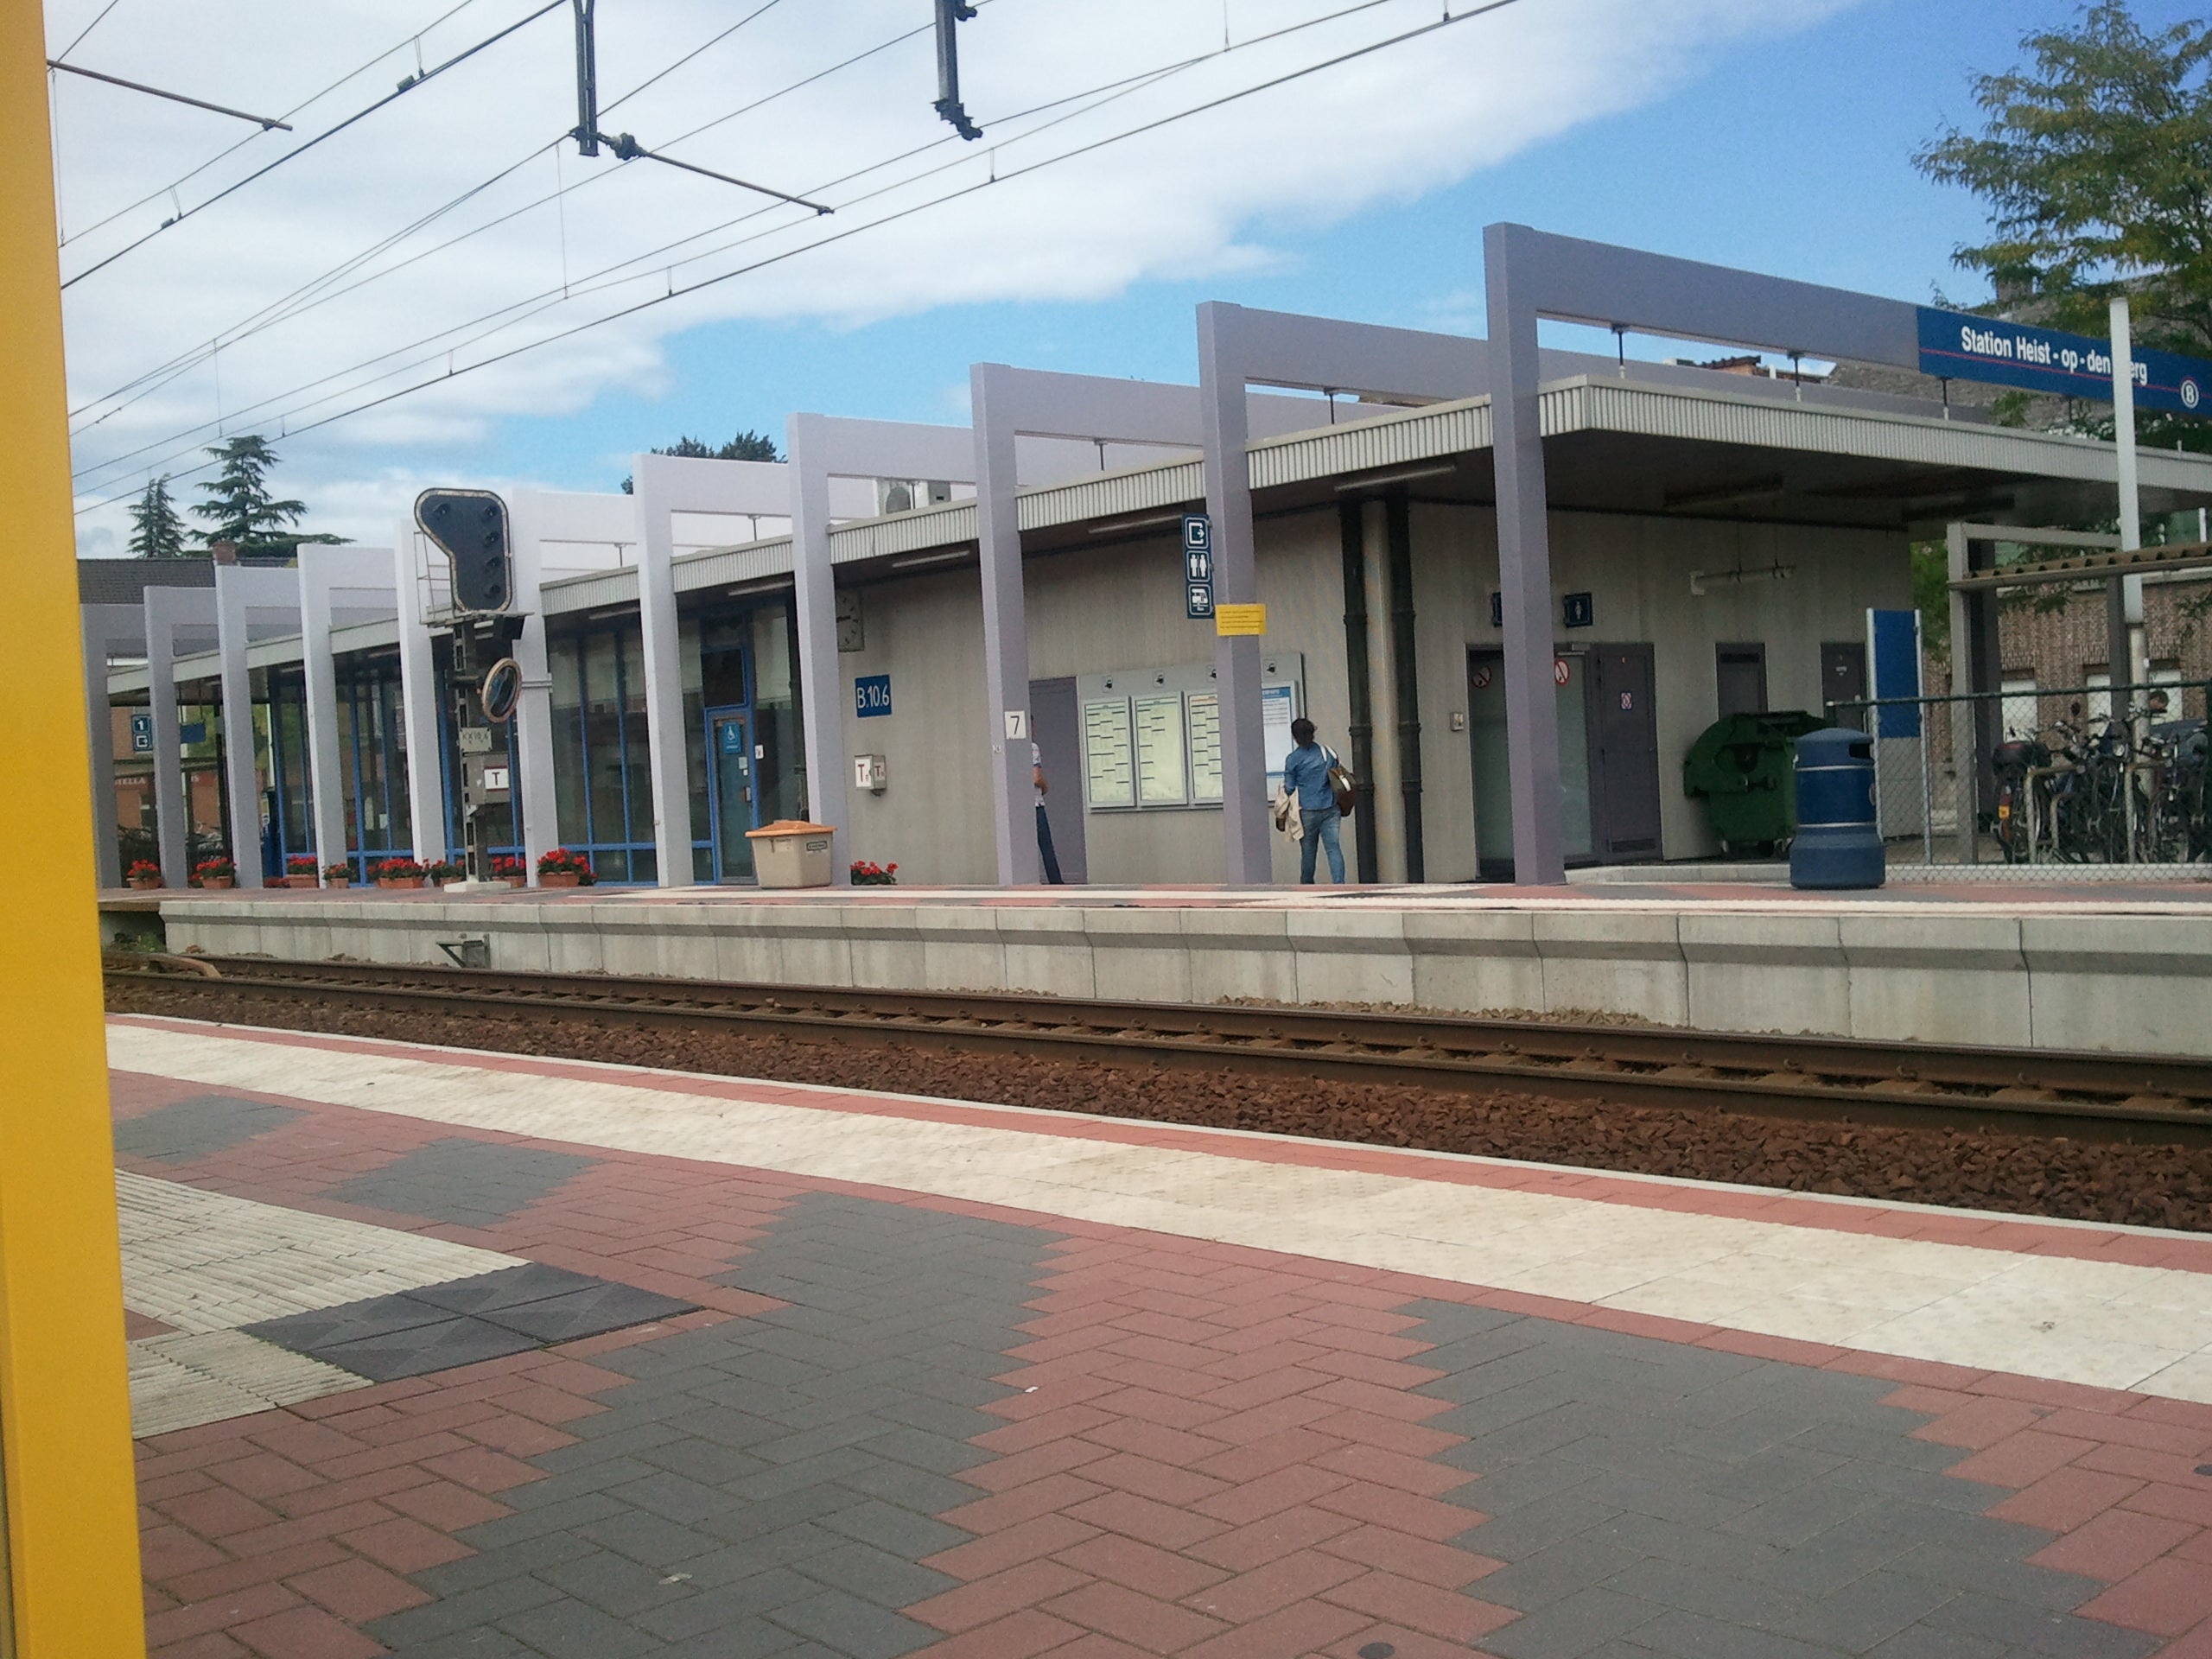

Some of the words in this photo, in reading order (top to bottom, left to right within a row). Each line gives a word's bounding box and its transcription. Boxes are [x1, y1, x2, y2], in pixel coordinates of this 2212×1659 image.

[1961, 326, 2012, 359] Station
[137, 720, 144, 730] 1
[1010, 715, 1020, 734] 7
[492, 771, 500, 785] T
